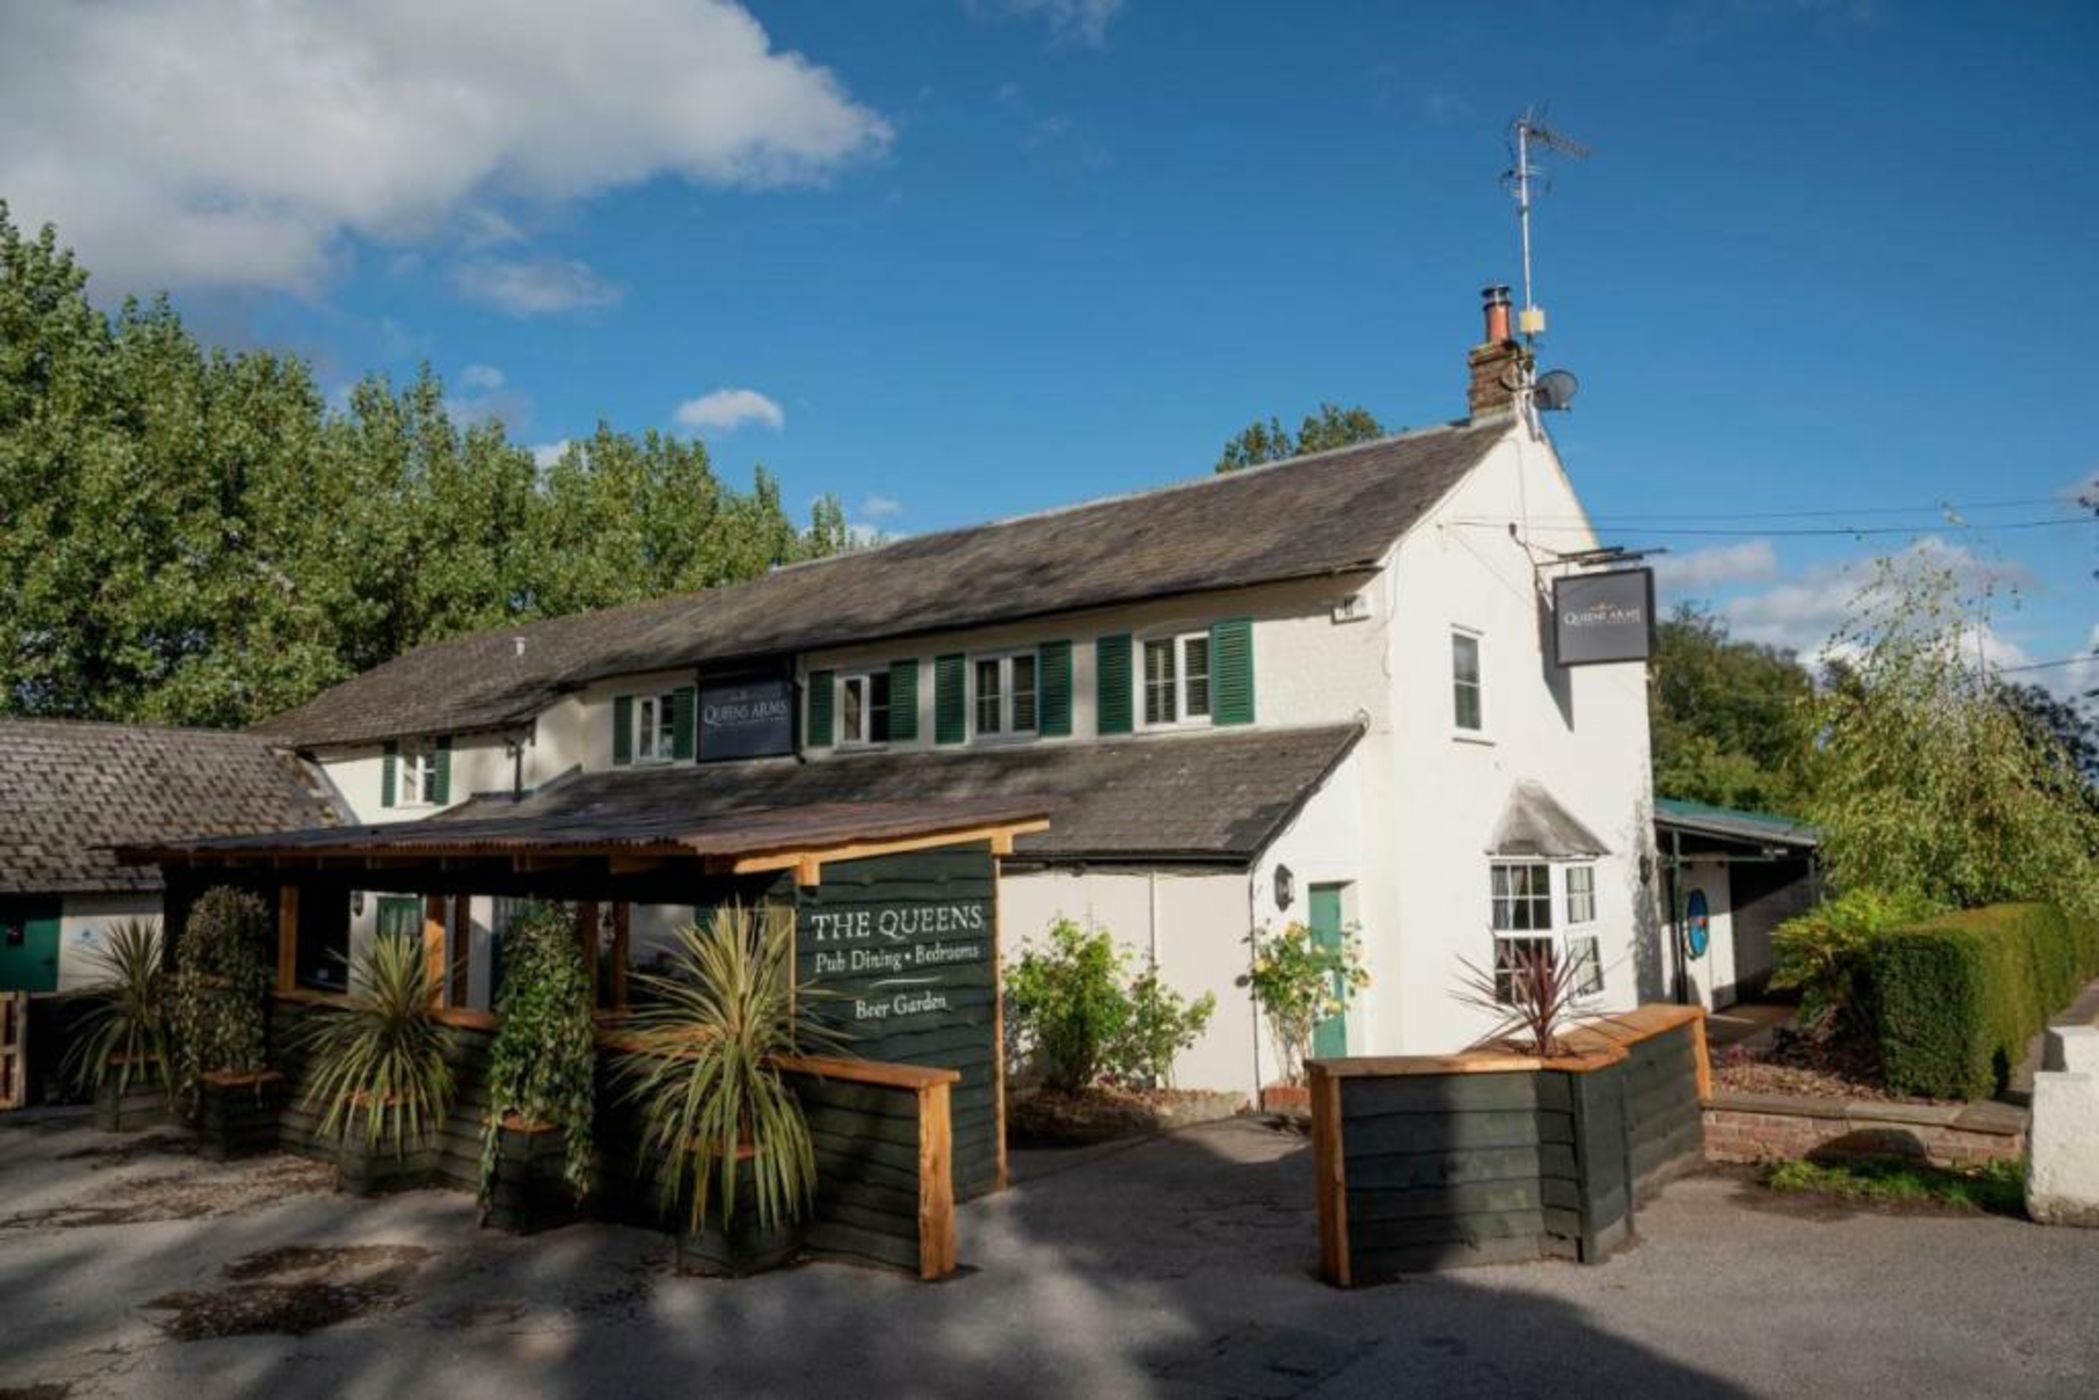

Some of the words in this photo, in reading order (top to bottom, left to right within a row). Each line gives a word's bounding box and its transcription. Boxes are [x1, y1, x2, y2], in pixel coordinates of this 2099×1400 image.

[751, 700, 787, 719] ARMS
[811, 911, 870, 941] THE
[878, 905, 983, 943] QUEENS
[815, 951, 845, 973] Pub
[852, 949, 901, 970] Dining
[915, 942, 979, 964] Bedrooms
[855, 1000, 889, 1020] Beer
[893, 990, 947, 1016] Garden
